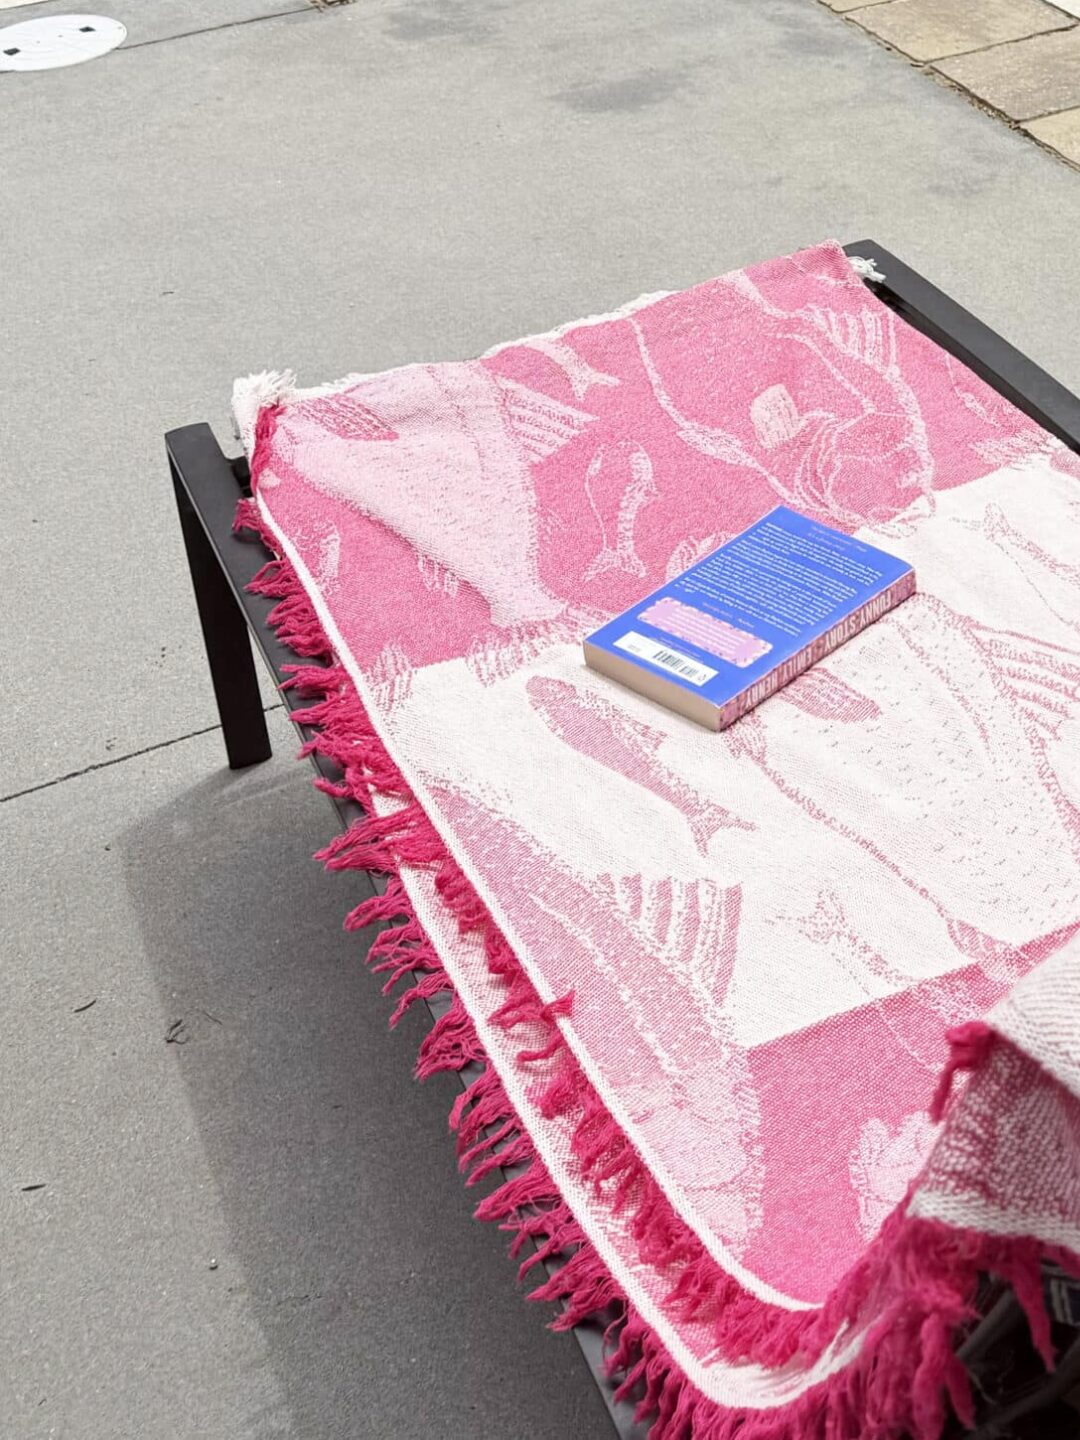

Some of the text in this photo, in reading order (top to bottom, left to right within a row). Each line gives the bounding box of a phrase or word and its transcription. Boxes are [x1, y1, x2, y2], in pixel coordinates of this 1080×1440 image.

[823, 589, 892, 651] FUNNY STORY
[745, 648, 813, 708] EMILY HENRY
